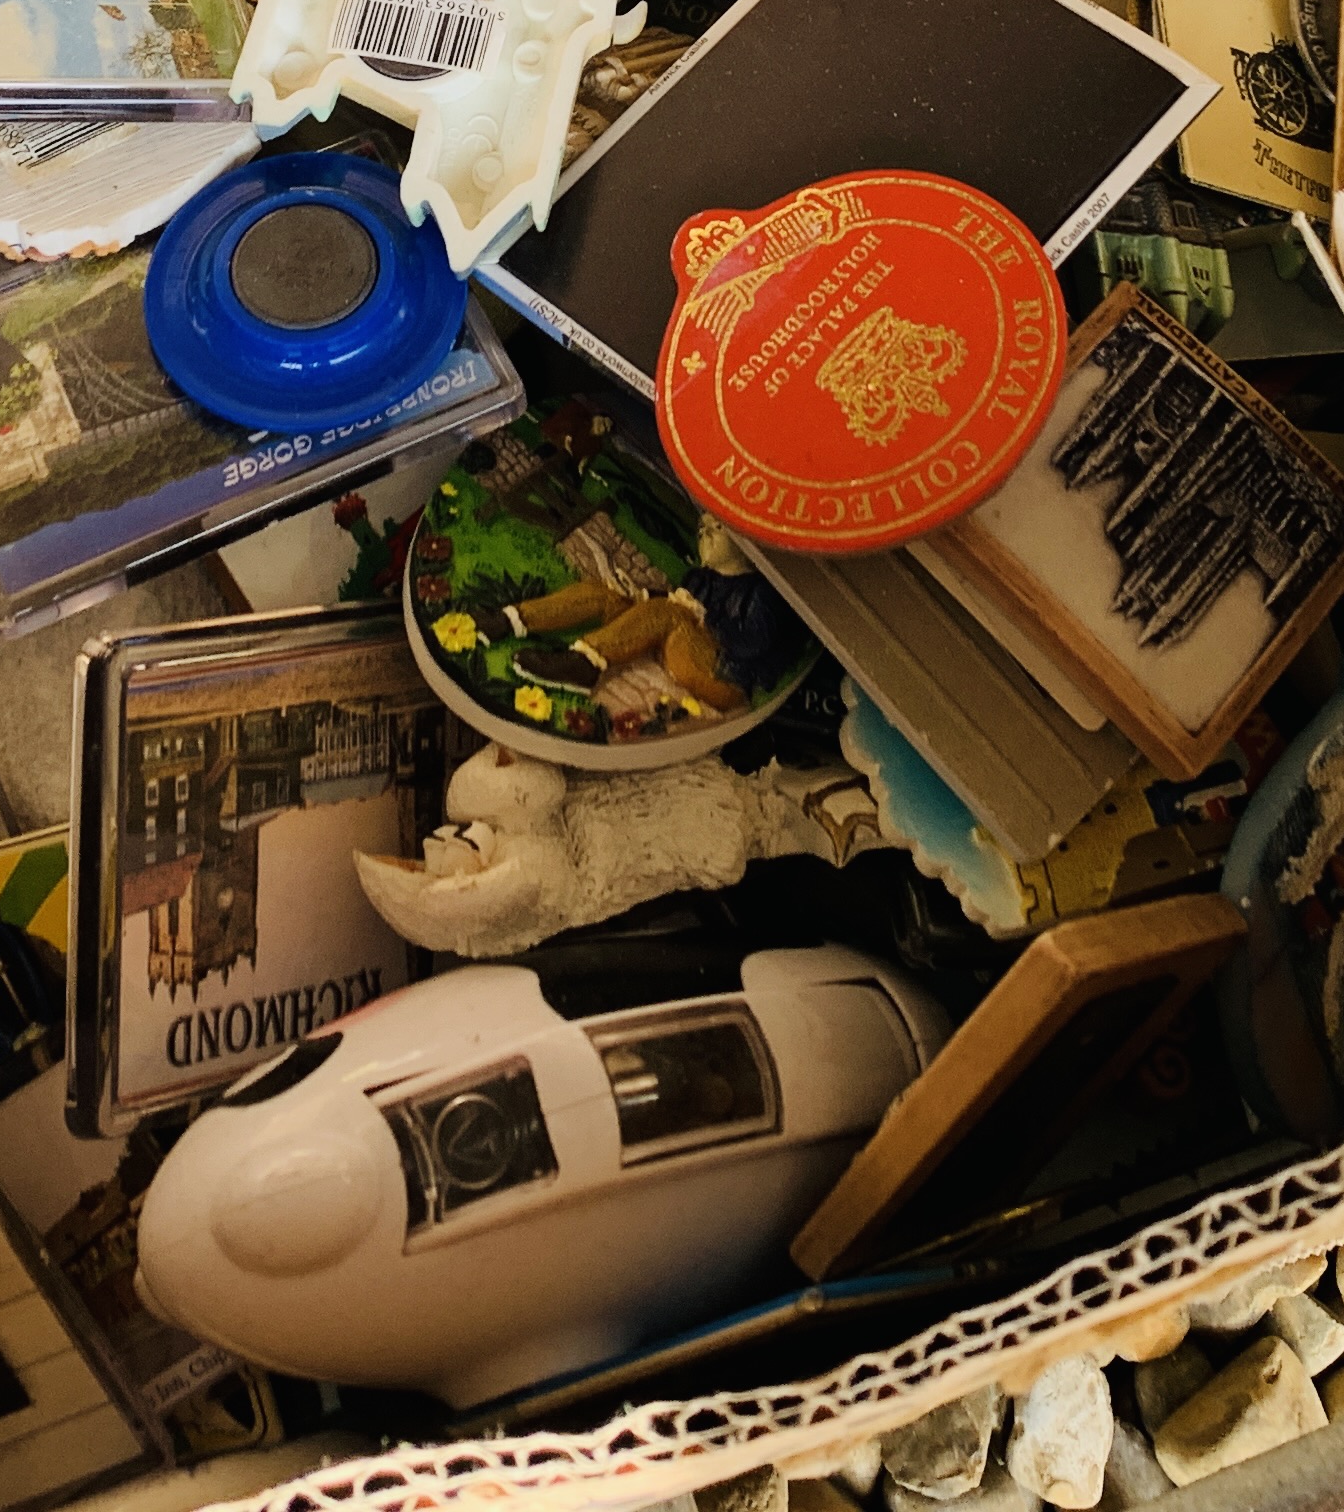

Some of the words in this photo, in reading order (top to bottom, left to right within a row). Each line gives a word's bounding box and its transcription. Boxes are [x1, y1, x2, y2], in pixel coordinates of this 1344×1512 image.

[1253, 138, 1335, 205] THETFO
[952, 204, 1022, 275] THE
[1060, 218, 1092, 251] Castle
[1086, 192, 1113, 220] 2007
[727, 231, 883, 394] HOLYROODHOUSE
[853, 258, 895, 302] THE
[786, 293, 864, 367] PALACE
[985, 295, 1048, 423] ROYAL
[1130, 291, 1251, 396] CATHEDRAL
[761, 364, 794, 399] OF
[221, 433, 314, 489] GORGE
[713, 438, 985, 528] COLLECTION
